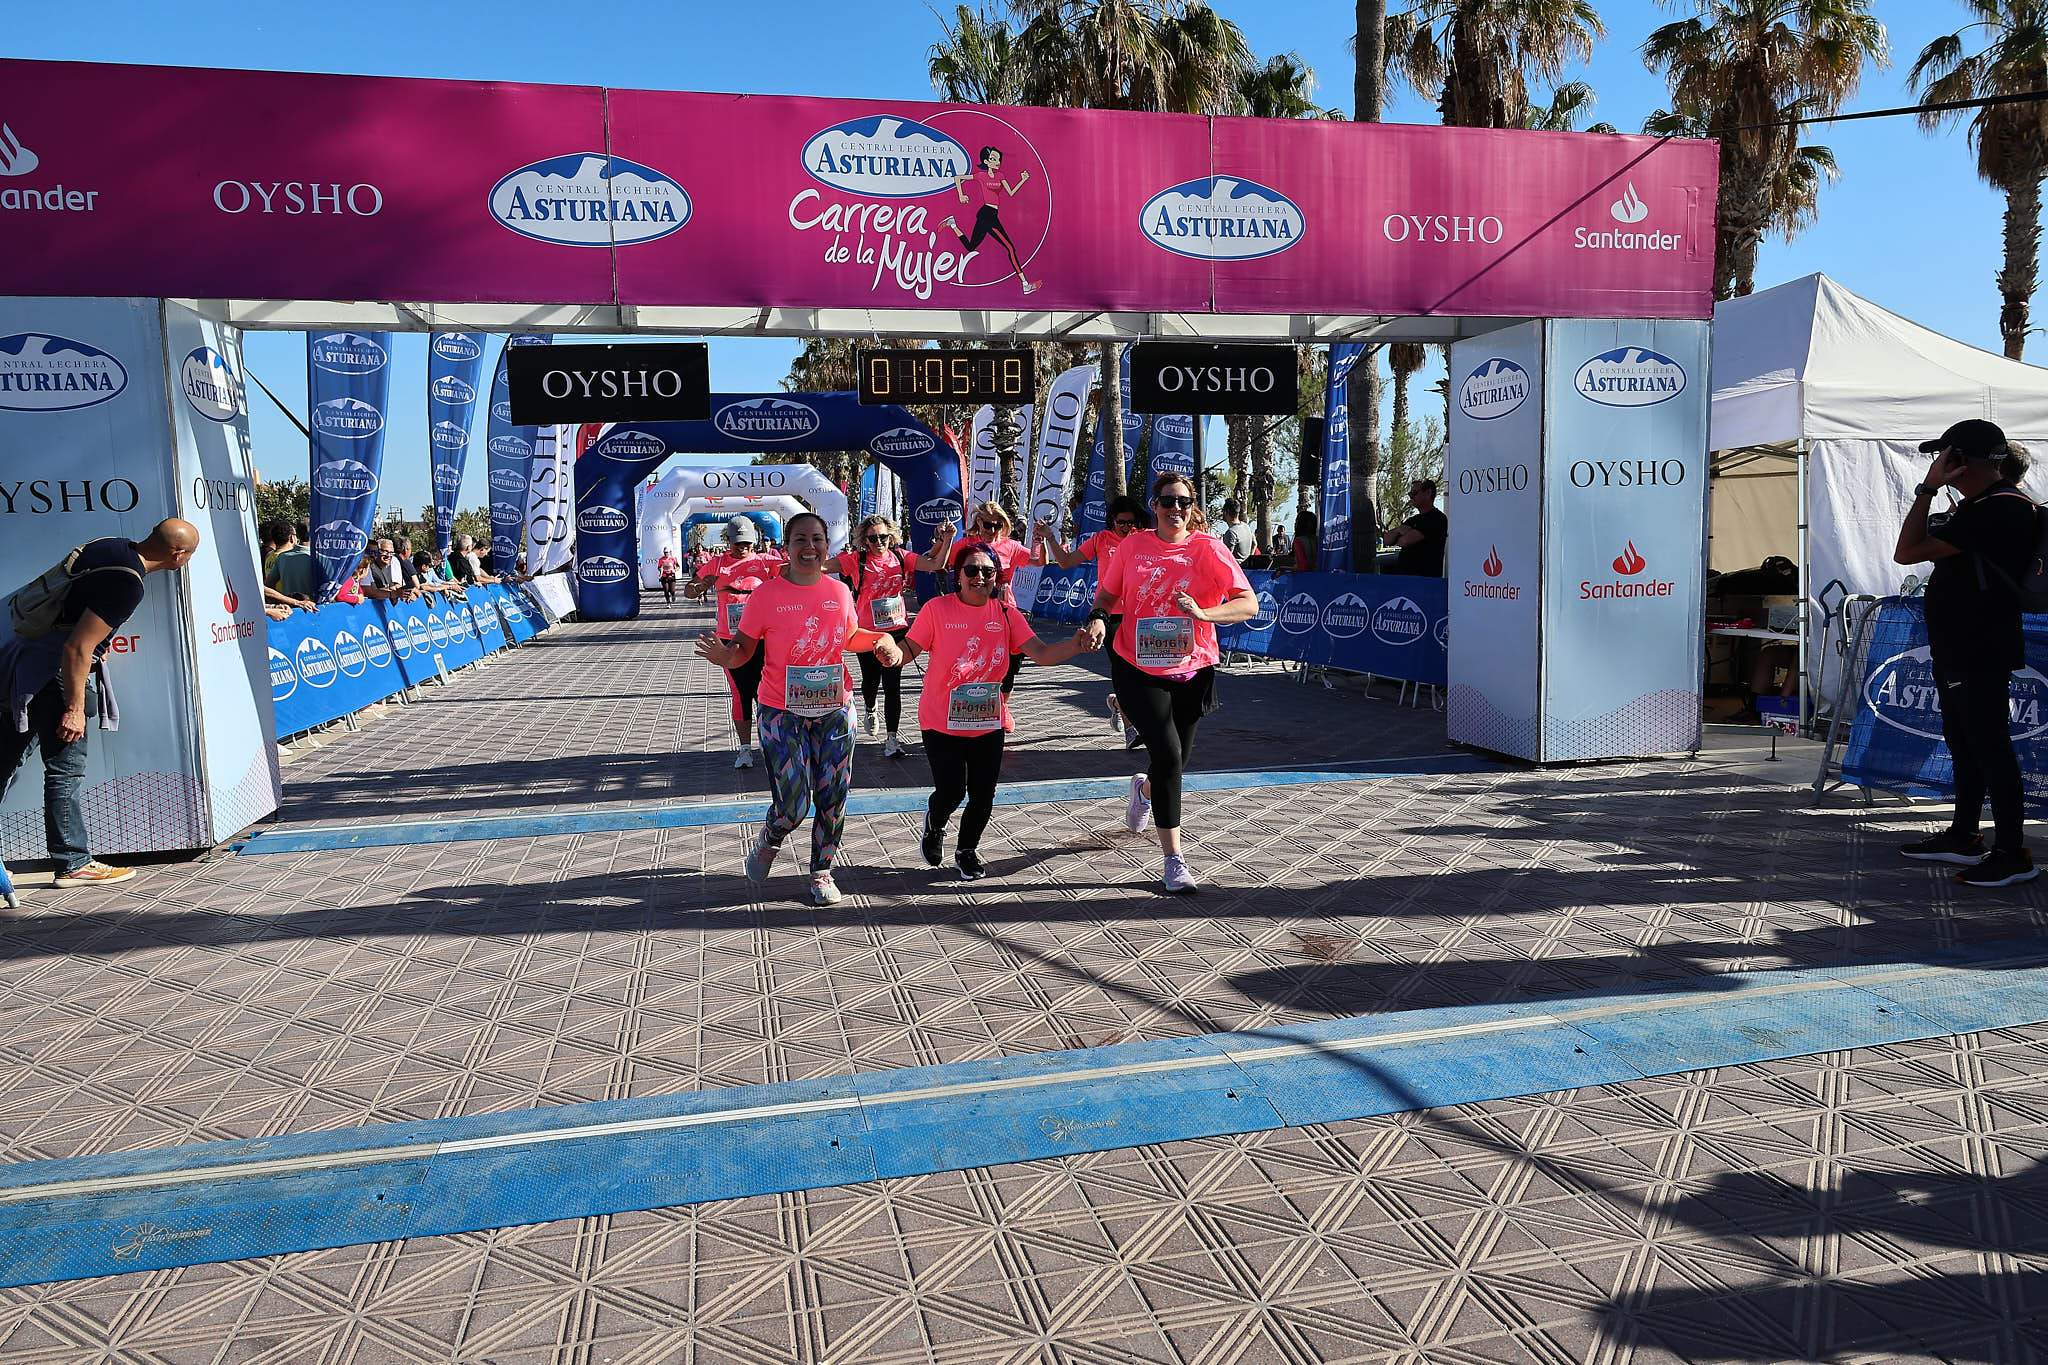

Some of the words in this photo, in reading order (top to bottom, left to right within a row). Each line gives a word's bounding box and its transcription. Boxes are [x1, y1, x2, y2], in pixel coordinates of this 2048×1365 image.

[841, 142, 894, 154] CENTRAL
[900, 145, 953, 155] LECHERA
[816, 143, 958, 178] ASTURIANA
[213, 180, 383, 216] OYSHO
[536, 184, 600, 195] CENTRAL
[506, 186, 677, 224] ASTURIANA
[788, 189, 928, 235] Carrera
[1178, 203, 1230, 214] CENTRAL
[1236, 206, 1287, 215] LECHERA
[1154, 204, 1292, 239] ASTURIANA
[1383, 214, 1503, 244] OYSHO
[1574, 226, 1681, 251] Santander
[825, 235, 850, 264] de
[856, 235, 874, 264] la
[872, 231, 979, 299] Mujer
[315, 346, 380, 365] ASTURIANA
[437, 341, 475, 356] ASTURIANA
[542, 370, 682, 398] OYSHO
[871, 359, 1021, 394] 01:05:18
[1159, 366, 1274, 392] OYSHO
[1583, 369, 1678, 392] ASTURIANA
[187, 370, 238, 407] ASTURIANA
[1464, 382, 1524, 409] ASTURIANA
[318, 408, 377, 429] ASTURIANA
[723, 411, 812, 430] ASTURIANA
[603, 442, 660, 454] ASTURIANA
[877, 440, 931, 451] ASTURIANA
[1033, 391, 1081, 526] OYSHO
[531, 424, 557, 545] OYSH
[703, 472, 785, 488] OYSHO
[1459, 464, 1528, 495] OYSHO
[1570, 459, 1685, 488] OYSHO
[193, 477, 249, 513] OYSHO
[580, 516, 624, 527] ASTURIANA
[919, 510, 961, 519] ASTURIAN
[581, 566, 626, 577] ASTURIANA
[1464, 581, 1520, 601] Santander
[1580, 579, 1674, 600] Santander
[777, 604, 803, 613] OYSHO
[1282, 609, 1315, 624] ASTURIANA
[1324, 609, 1364, 628] ASTURIANA
[212, 619, 255, 646] Santander
[1375, 614, 1420, 635] ASTURIANA
[300, 658, 336, 678] ASTURIANA
[1877, 670, 2039, 726] ASTUNA
